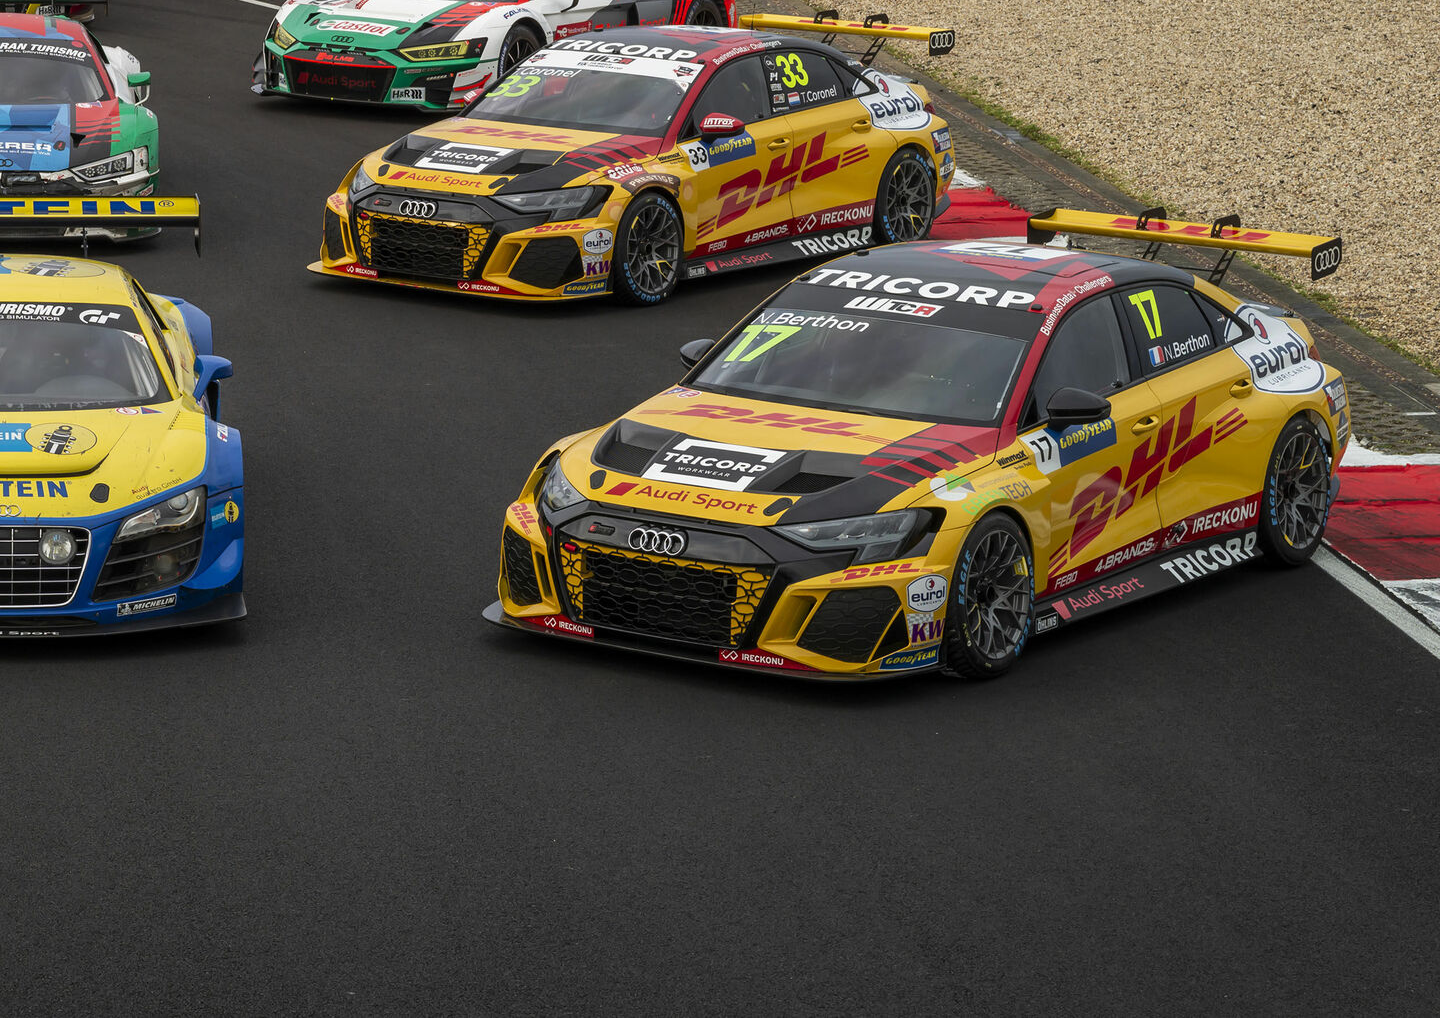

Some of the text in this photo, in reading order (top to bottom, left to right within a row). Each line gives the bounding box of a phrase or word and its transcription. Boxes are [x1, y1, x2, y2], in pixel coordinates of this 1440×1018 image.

[333, 20, 391, 35] Castrol
[31, 44, 87, 59] TURISMO
[550, 39, 698, 61] TRICORP
[311, 73, 377, 89] Audi Sport
[775, 53, 809, 88] 33
[485, 76, 542, 98] 33
[800, 85, 838, 104] T.Coronel
[870, 90, 924, 119] eurol
[432, 149, 499, 163] TRICORP
[688, 146, 707, 165] 33
[406, 171, 483, 189] Audi Sport
[629, 174, 675, 187] PRESTIGE
[717, 131, 840, 230] DHL
[821, 205, 873, 226] IRECKONU
[532, 223, 588, 234] DHL
[585, 237, 612, 248] eurol
[792, 226, 872, 256] TRICORP
[586, 260, 610, 276] KW
[719, 250, 773, 269] Audi Sport
[471, 284, 500, 292] IRECKONU
[566, 281, 605, 292] GOODYEAR
[807, 268, 1036, 308] TRICORP
[1074, 275, 1113, 296] Challengers
[843, 296, 946, 318] WTCR
[1128, 289, 1163, 339] 17
[750, 312, 870, 333] N.Berthon
[723, 325, 803, 362] 17
[1164, 333, 1210, 360] N.Berthon
[1250, 333, 1308, 378] eurol
[1267, 364, 1312, 386] LUBRICANTS
[671, 403, 864, 438] DHL
[1060, 419, 1113, 450] GOODYEAR
[1029, 436, 1052, 463] 17
[662, 452, 768, 474] TRICORP
[676, 465, 731, 478] WORKWEAR
[161, 477, 183, 489] GmbH
[1068, 395, 1214, 560] DHL
[634, 484, 759, 515] Audi Sport
[1192, 501, 1258, 534] IRECKONU
[1160, 531, 1257, 583] TRICORP
[843, 563, 922, 581] DHL
[958, 549, 973, 605] EAGLE
[1054, 570, 1078, 589] FEBO
[133, 597, 175, 611] MICHELIN
[911, 586, 945, 602] eurol
[1068, 575, 1144, 612] Audi Sport
[559, 622, 592, 635] IRECKONU
[912, 618, 946, 643] KW
[1037, 615, 1058, 631] ÖHLINS
[741, 653, 784, 666] IRECKONU
[885, 649, 937, 666] GOODYEAR
